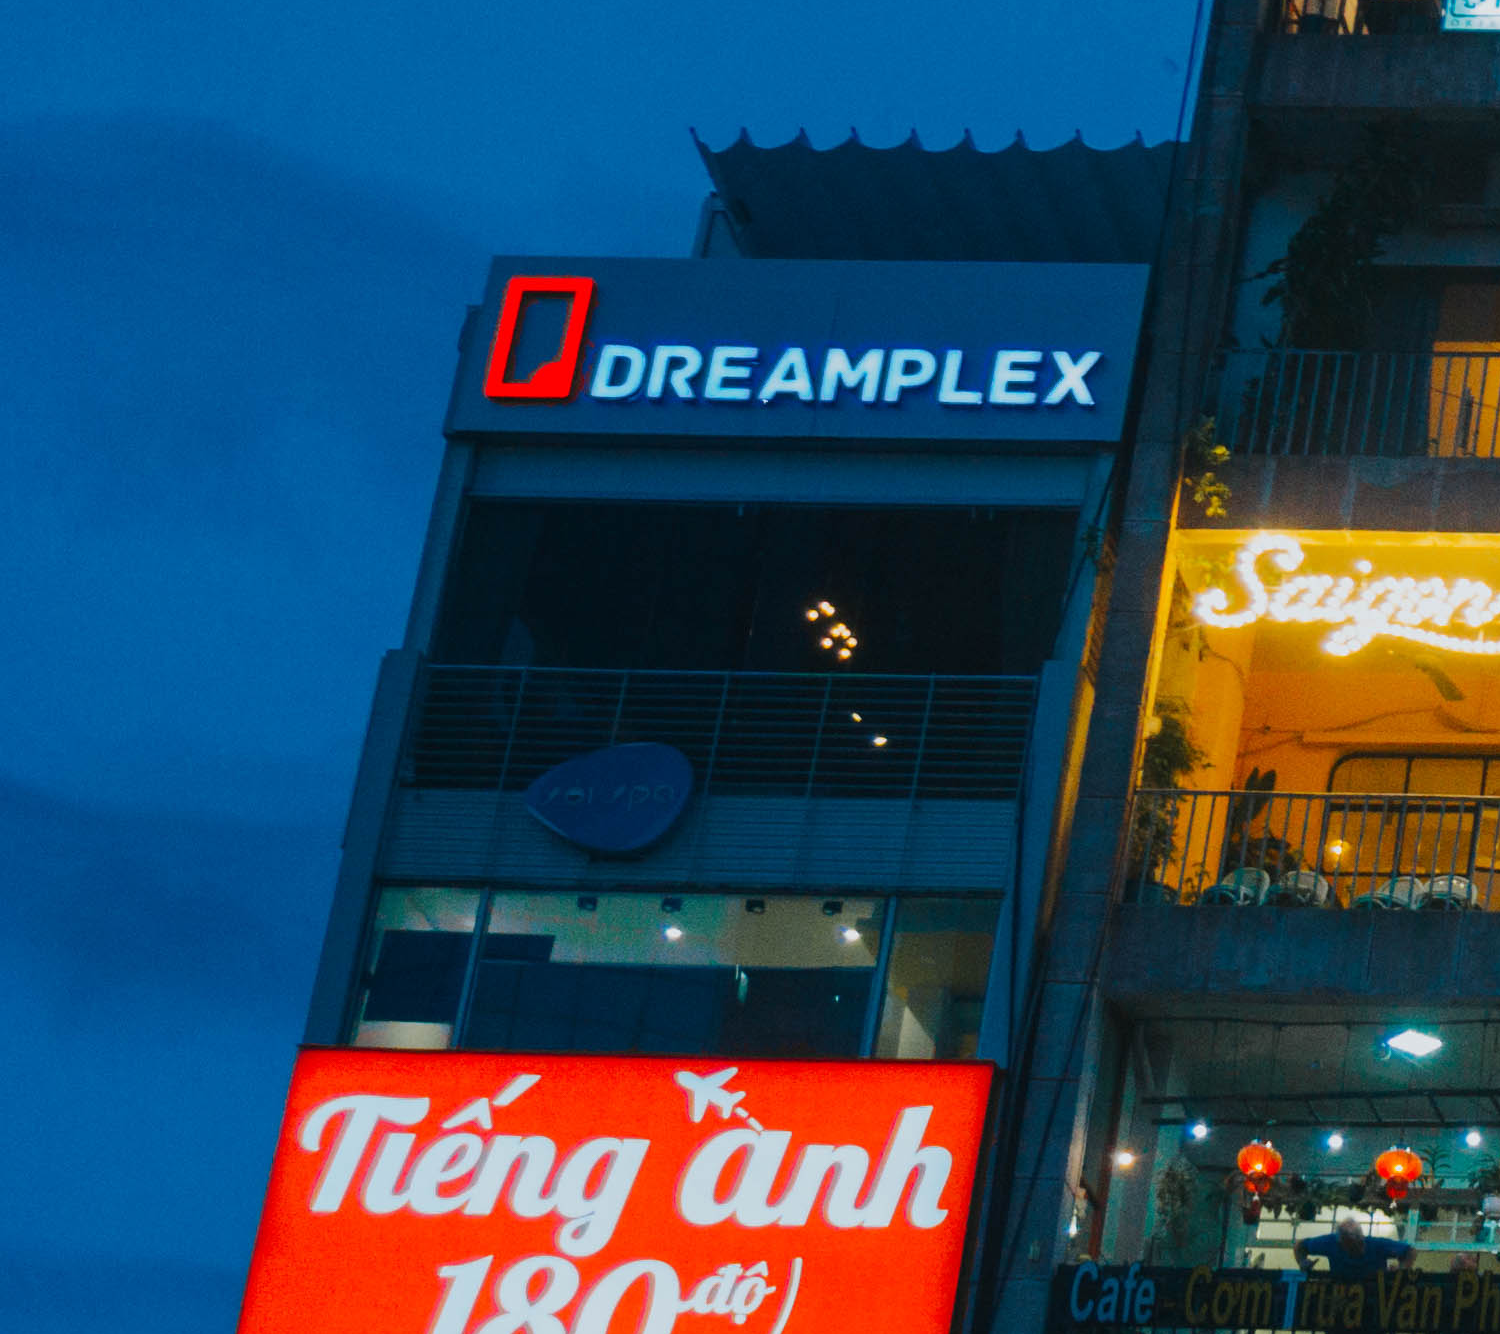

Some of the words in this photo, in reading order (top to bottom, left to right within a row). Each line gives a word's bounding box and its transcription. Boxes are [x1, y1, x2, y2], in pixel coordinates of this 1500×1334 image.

[591, 343, 1104, 407] DREAMPLEX
[300, 1073, 650, 1258] Tiếng
[1069, 1261, 1156, 1324] Cafe
